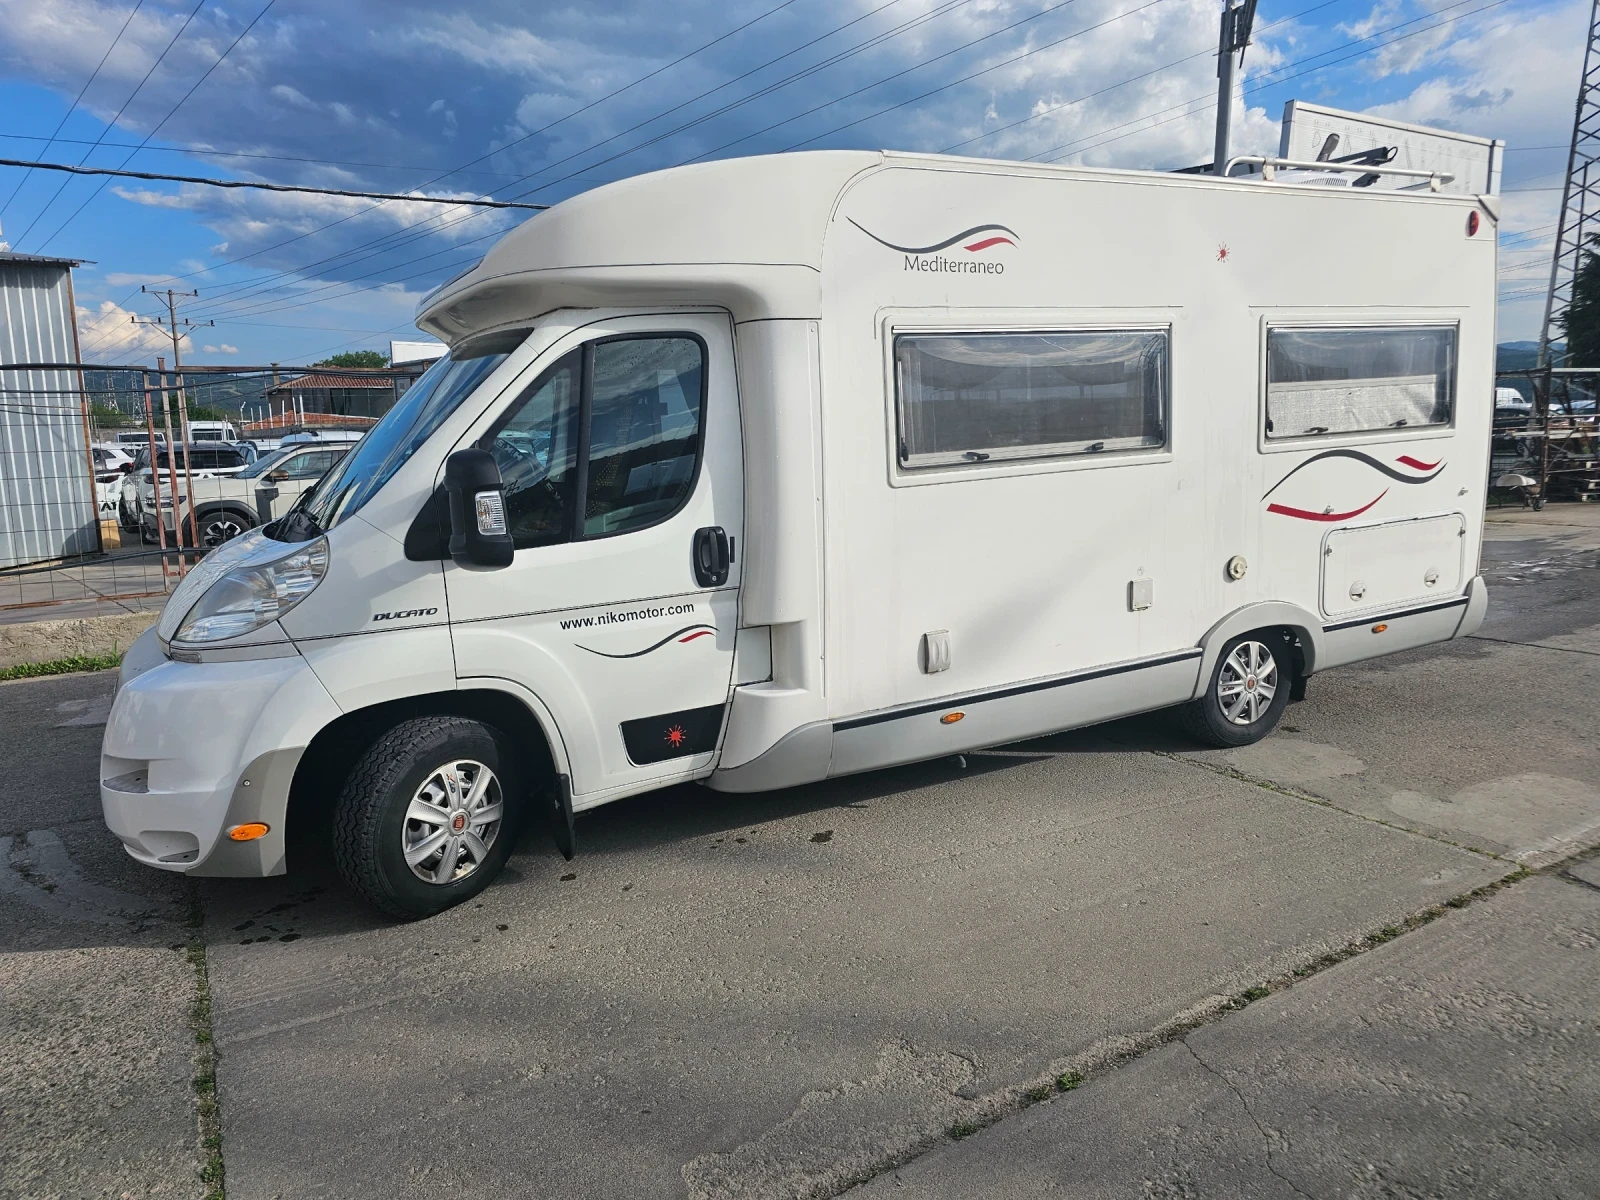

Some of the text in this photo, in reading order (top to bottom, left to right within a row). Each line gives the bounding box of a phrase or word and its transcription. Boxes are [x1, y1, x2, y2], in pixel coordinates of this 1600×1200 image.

[904, 255, 1004, 274] Mediterraneo
[372, 607, 438, 622] DUCATO
[560, 603, 694, 630] www.nikomotor.com
